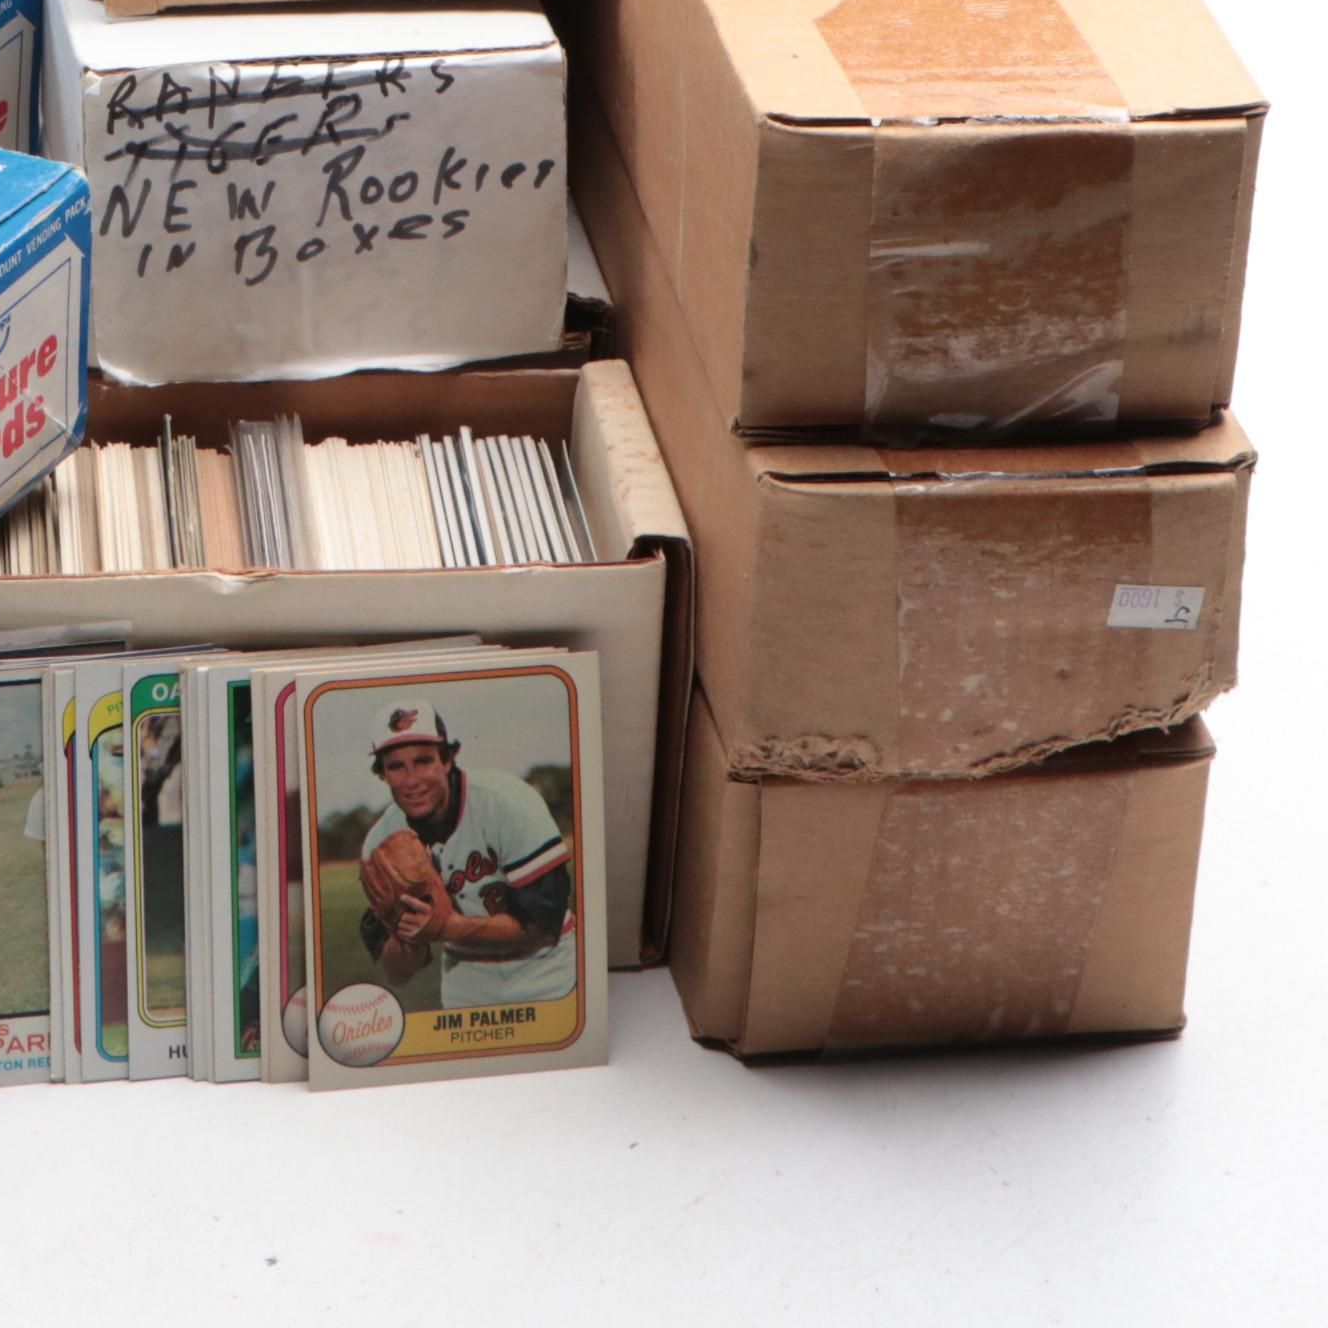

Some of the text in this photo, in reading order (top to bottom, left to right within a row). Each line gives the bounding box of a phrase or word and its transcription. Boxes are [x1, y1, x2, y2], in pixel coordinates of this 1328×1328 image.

[26, 217, 62, 256] VENDING
[64, 197, 87, 223] PACK
[99, 179, 276, 238] NEW
[331, 1009, 393, 1046] Orioles
[432, 1007, 537, 1031] JIM PALMER
[450, 1027, 516, 1045] PITCHER
